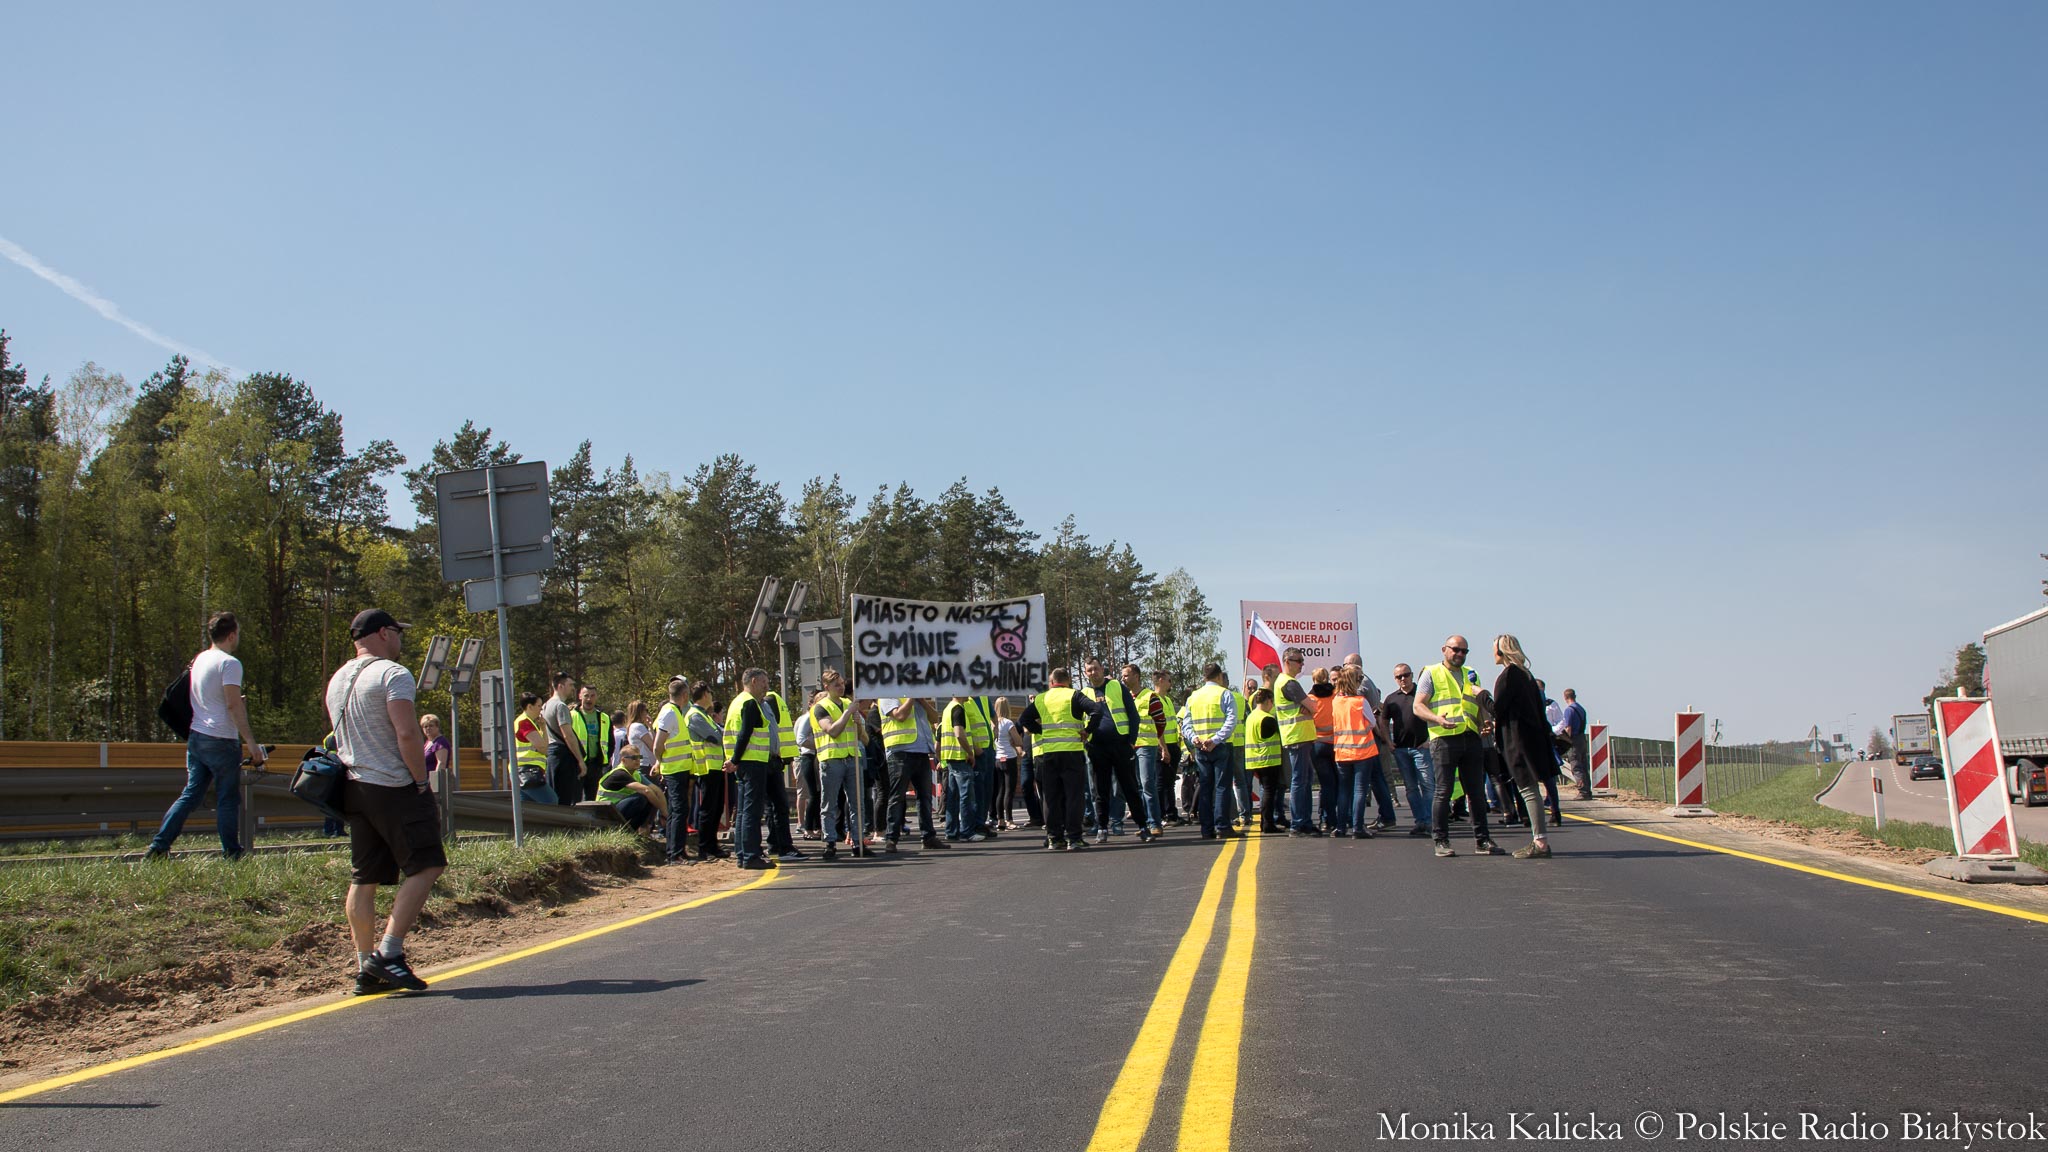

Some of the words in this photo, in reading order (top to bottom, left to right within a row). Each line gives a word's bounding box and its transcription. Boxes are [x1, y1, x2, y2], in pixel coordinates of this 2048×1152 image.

[945, 600, 1031, 624] NASZEJ
[1246, 620, 1316, 630] PZYDENCIE
[1319, 621, 1353, 630] DROGI
[1281, 634, 1331, 644] ZABIERAJ
[1299, 647, 1325, 657] ROGI
